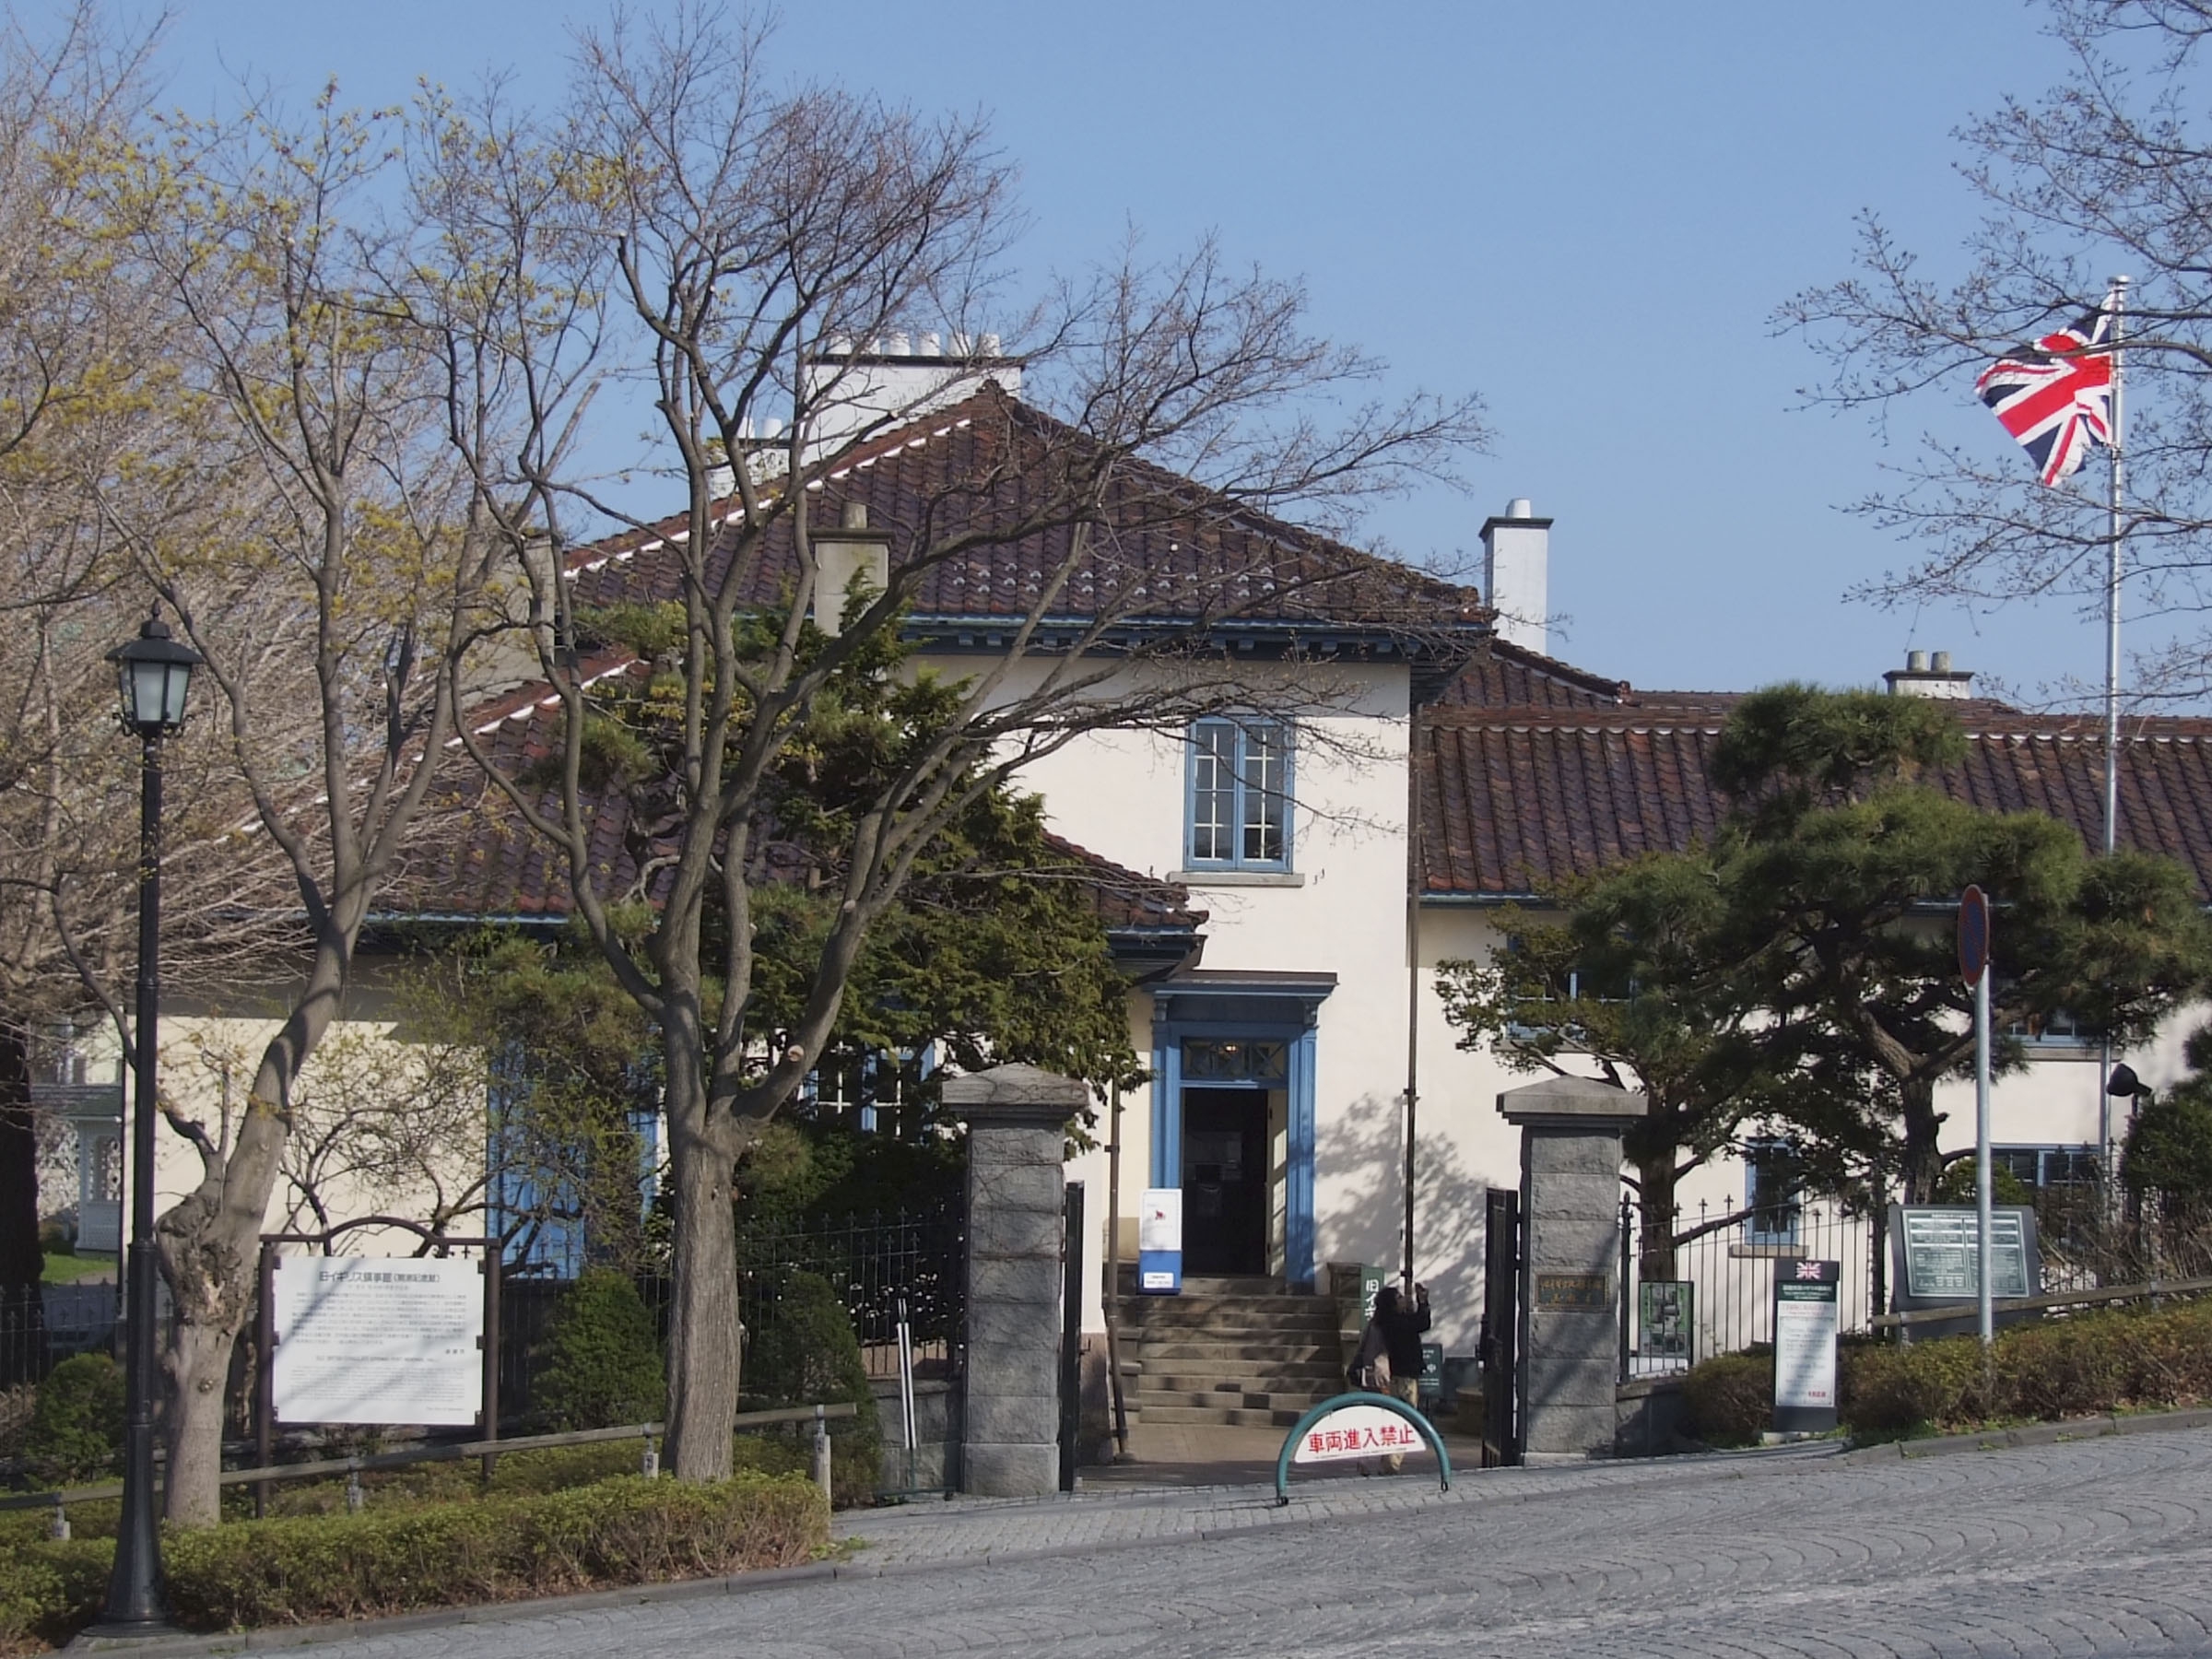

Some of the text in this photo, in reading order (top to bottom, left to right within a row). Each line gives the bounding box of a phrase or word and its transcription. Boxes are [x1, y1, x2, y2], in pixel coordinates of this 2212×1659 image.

[1365, 1279, 1379, 1321] 旧イギ
[1309, 1423, 1416, 1453] 車両進入禁止
